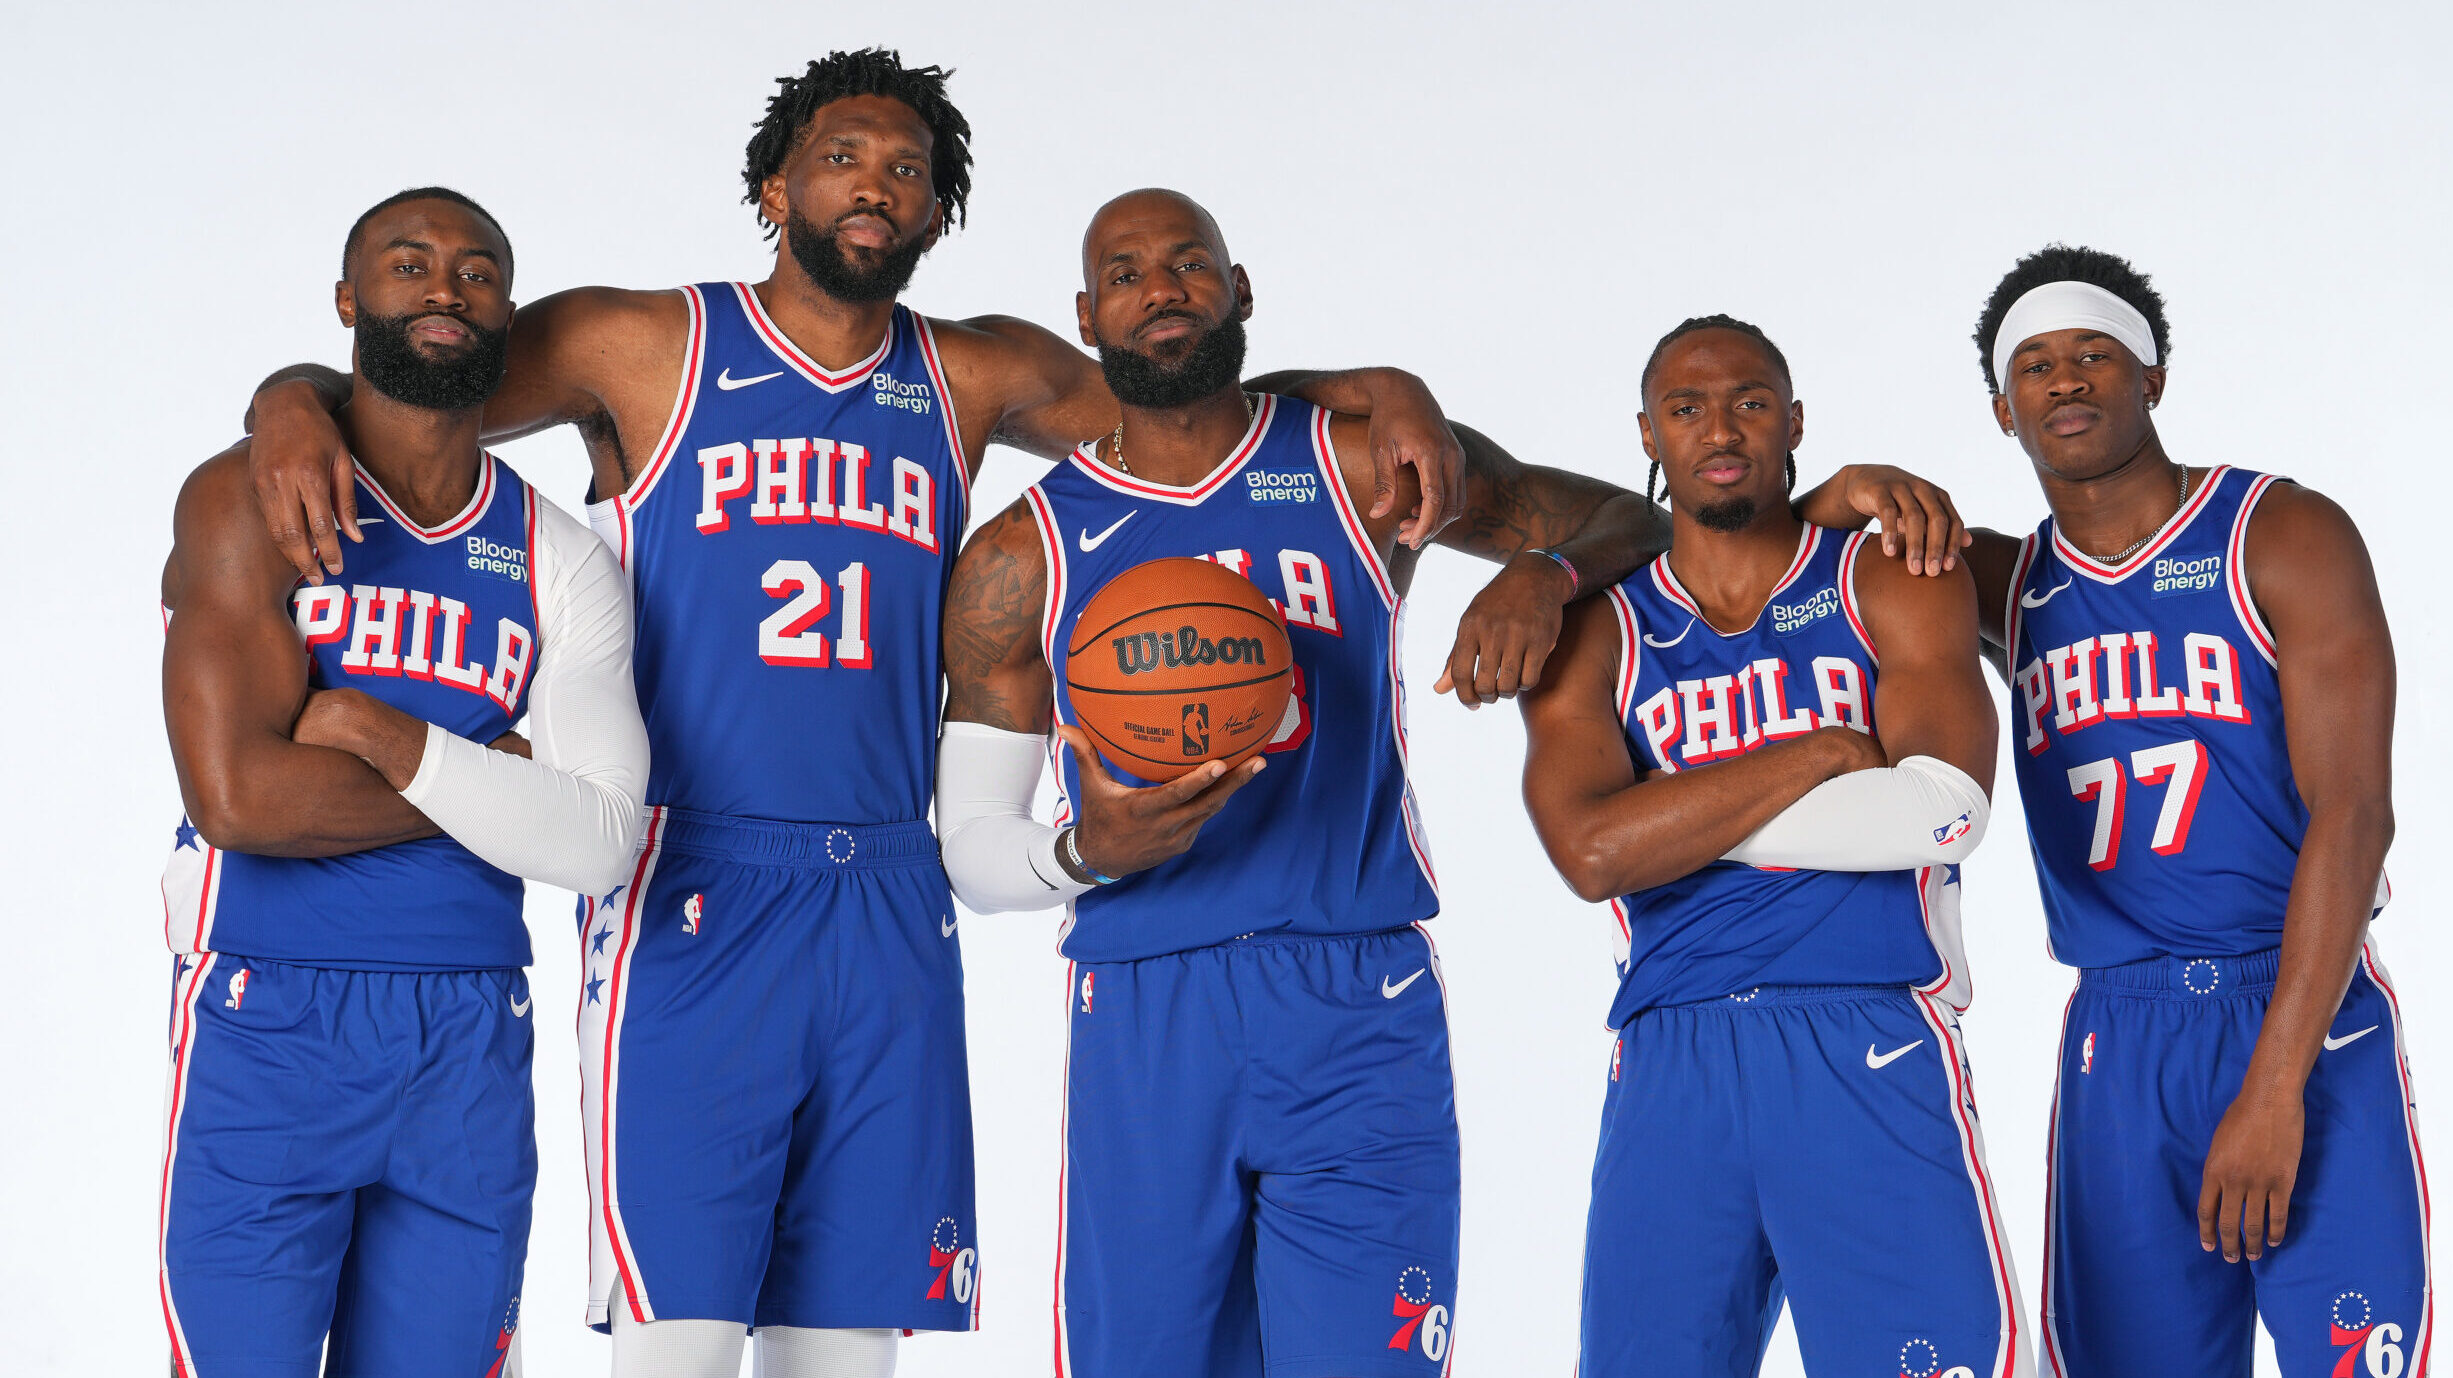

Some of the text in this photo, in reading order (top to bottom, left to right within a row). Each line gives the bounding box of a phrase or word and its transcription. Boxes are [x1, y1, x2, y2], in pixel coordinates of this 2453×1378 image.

[873, 373, 930, 397] Bloom
[875, 392, 931, 415] energy
[1245, 470, 1316, 488] Bloom
[1250, 486, 1317, 503] energy
[695, 437, 940, 556] PHILA
[466, 536, 528, 564] Bloom
[2154, 556, 2221, 578] Bloom
[467, 556, 529, 584] energy
[2153, 571, 2220, 592] energy
[758, 559, 873, 670] 21
[1772, 587, 1838, 621] Bloom
[1774, 600, 1839, 632] energy
[293, 583, 534, 719] PHILA
[1112, 625, 1267, 676] Wilson
[2016, 630, 2252, 758] PHILA
[1123, 721, 1146, 734] OFFICIAL
[1162, 727, 1176, 737] BALL
[1634, 655, 1877, 775] PHILA
[2066, 738, 2210, 873] 77
[925, 1243, 976, 1304] 76
[1387, 1292, 1449, 1362] 76
[2331, 1321, 2404, 1378] 76
